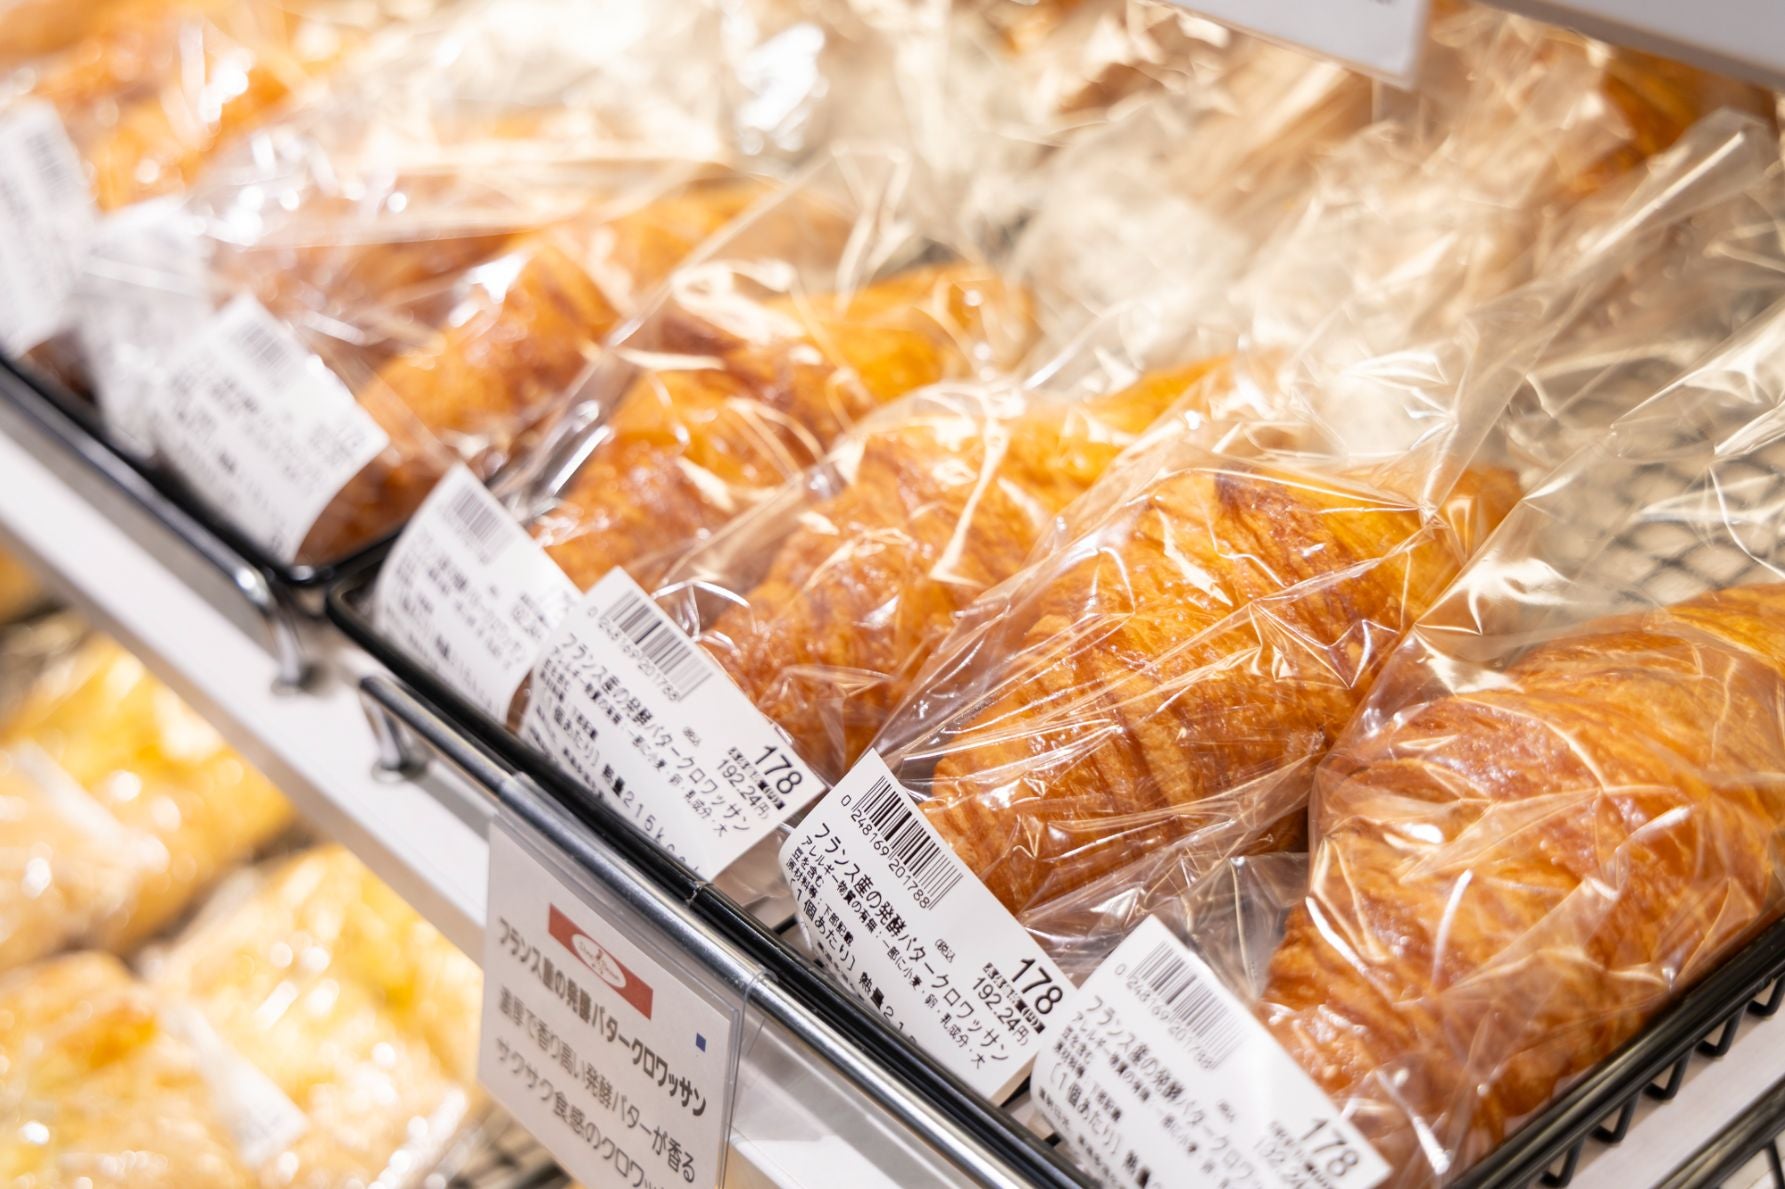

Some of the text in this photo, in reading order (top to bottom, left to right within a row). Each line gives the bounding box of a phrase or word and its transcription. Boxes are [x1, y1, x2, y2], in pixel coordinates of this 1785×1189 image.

[754, 743, 803, 796] 178
[793, 846, 825, 885] 豆を含む
[841, 794, 930, 910] 0 248169 201788
[813, 822, 1010, 1063] フランス産の発酵バタークロワッサン
[1114, 962, 1127, 977] 0
[1011, 956, 1064, 1016] 178
[1302, 1118, 1360, 1178] 178
